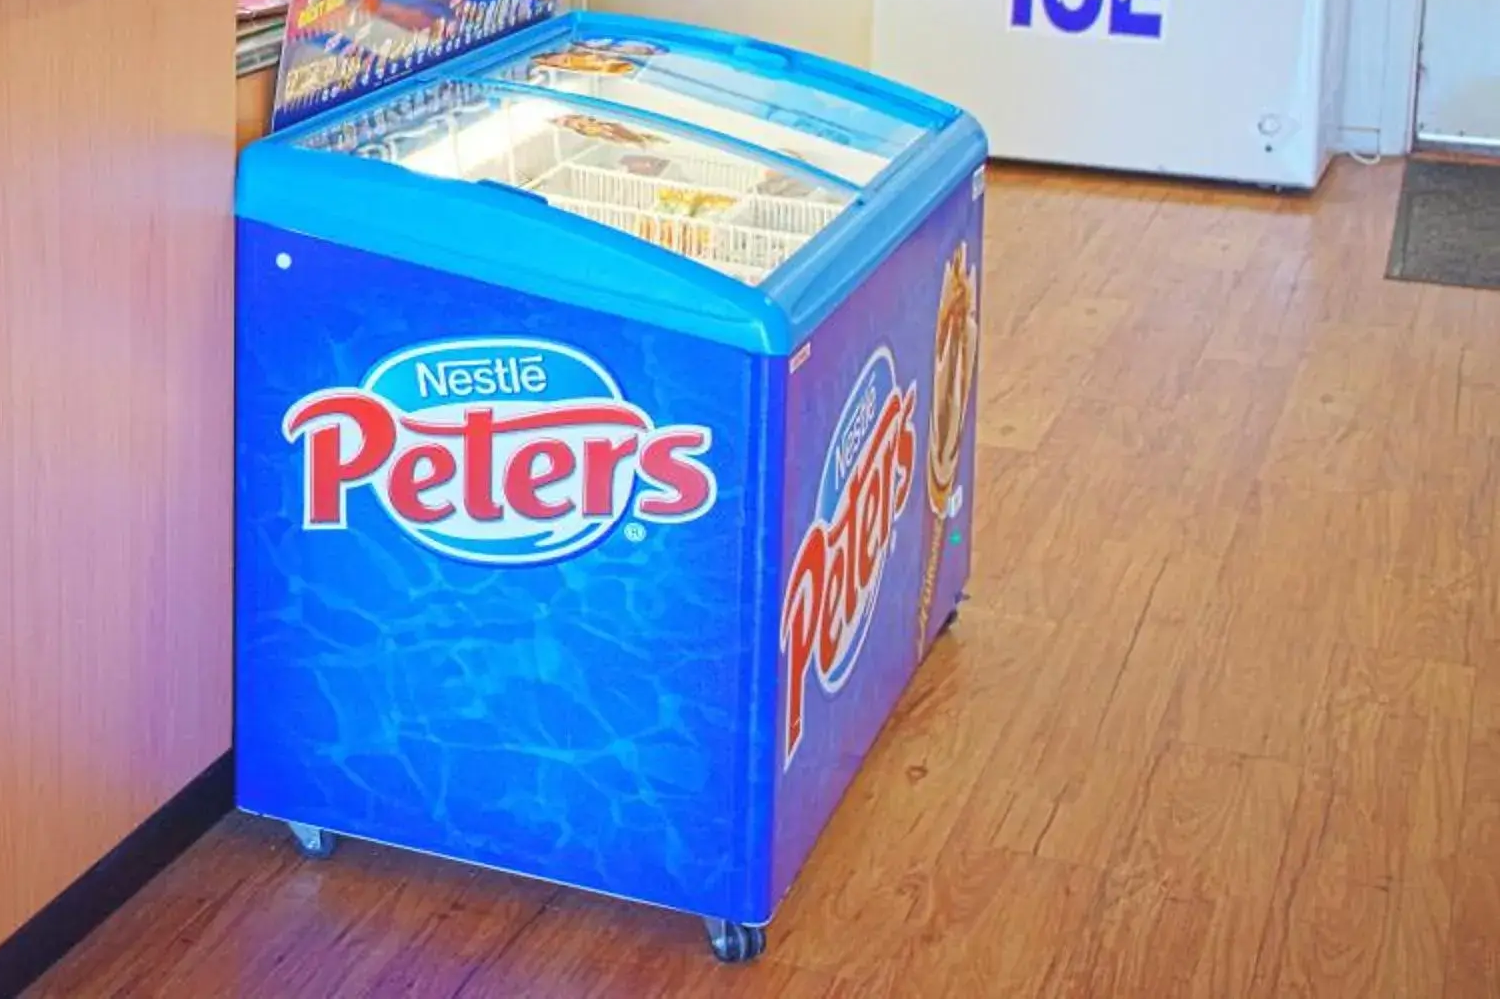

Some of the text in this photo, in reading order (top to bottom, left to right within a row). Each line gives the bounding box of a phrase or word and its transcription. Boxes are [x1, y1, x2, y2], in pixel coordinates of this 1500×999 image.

[415, 355, 548, 398] Nestlé
[284, 389, 716, 529] Peters
[780, 379, 919, 773] Peters
